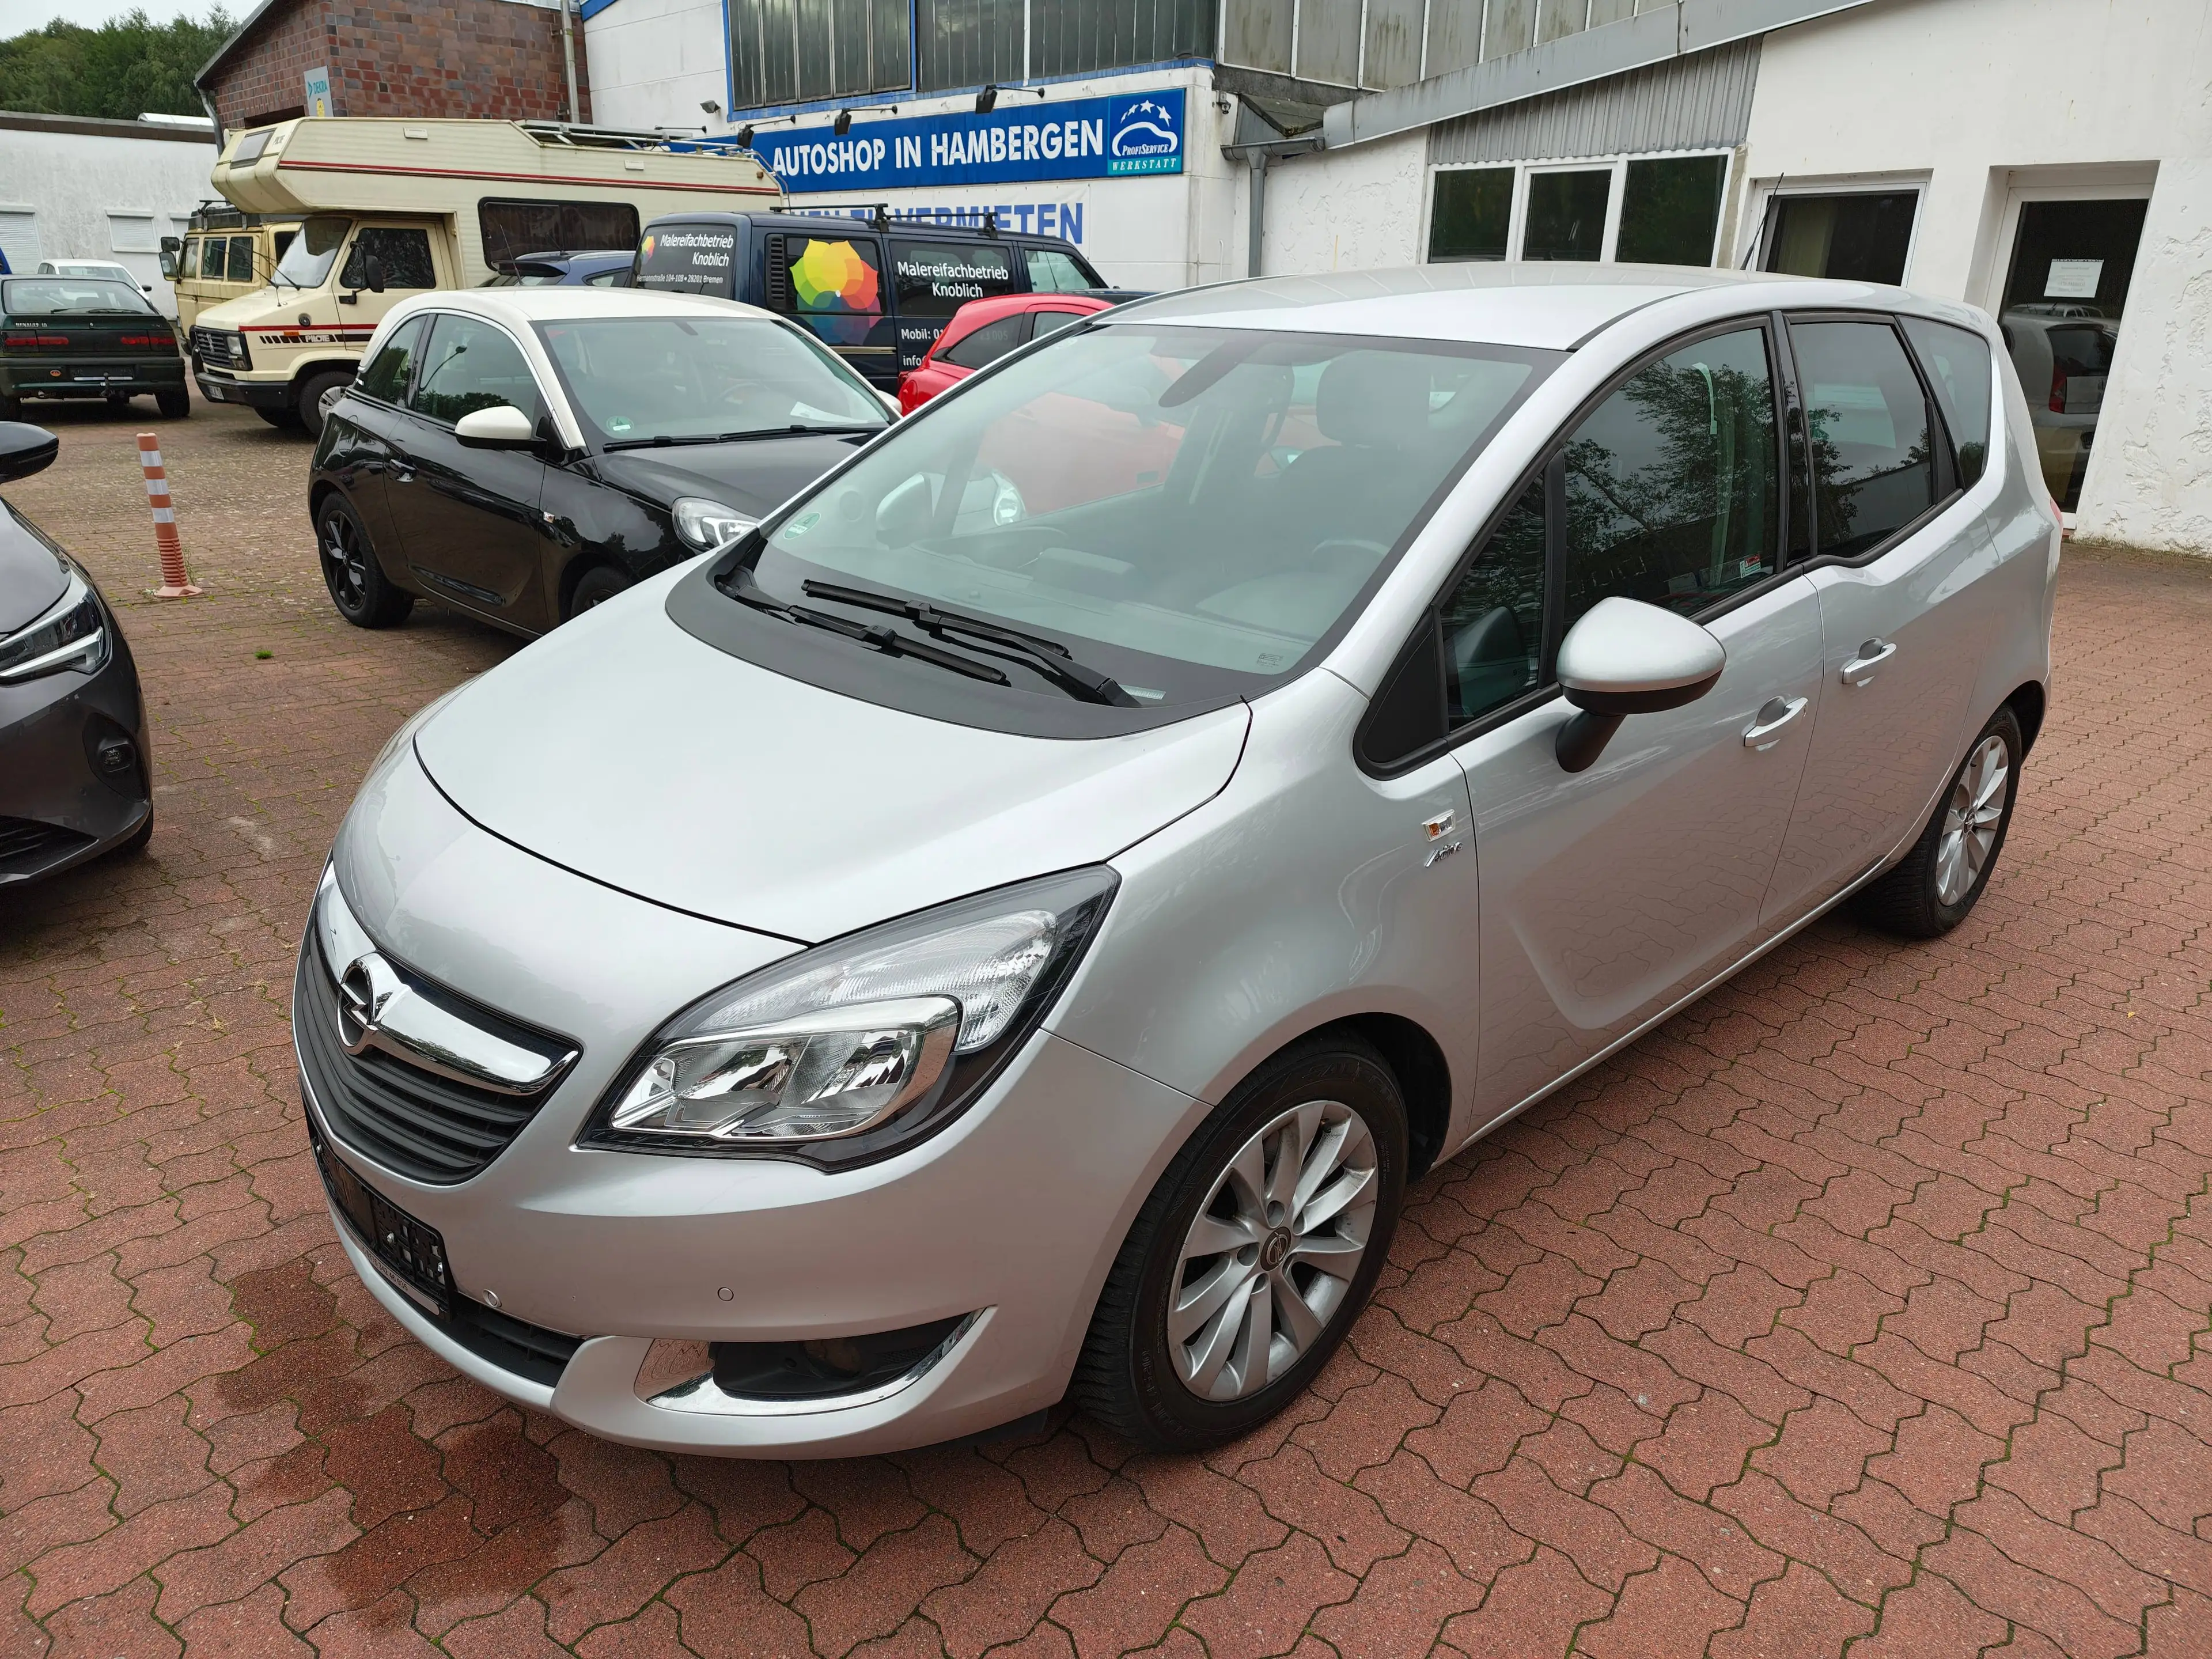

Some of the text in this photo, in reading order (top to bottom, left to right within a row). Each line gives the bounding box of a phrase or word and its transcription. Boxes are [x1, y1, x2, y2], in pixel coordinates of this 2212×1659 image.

[773, 119, 1103, 176] AUTOSHOP IN HAMBERGEN
[1112, 158, 1176, 171] WERKSTATT
[660, 234, 734, 249] Malereifachbetrieb
[692, 252, 729, 267] Knoblich
[897, 261, 1009, 280] Malereifachbetrieb
[931, 282, 983, 298] Knoblich
[305, 334, 330, 343] PILOTE
[901, 328, 931, 339] Mobil:
